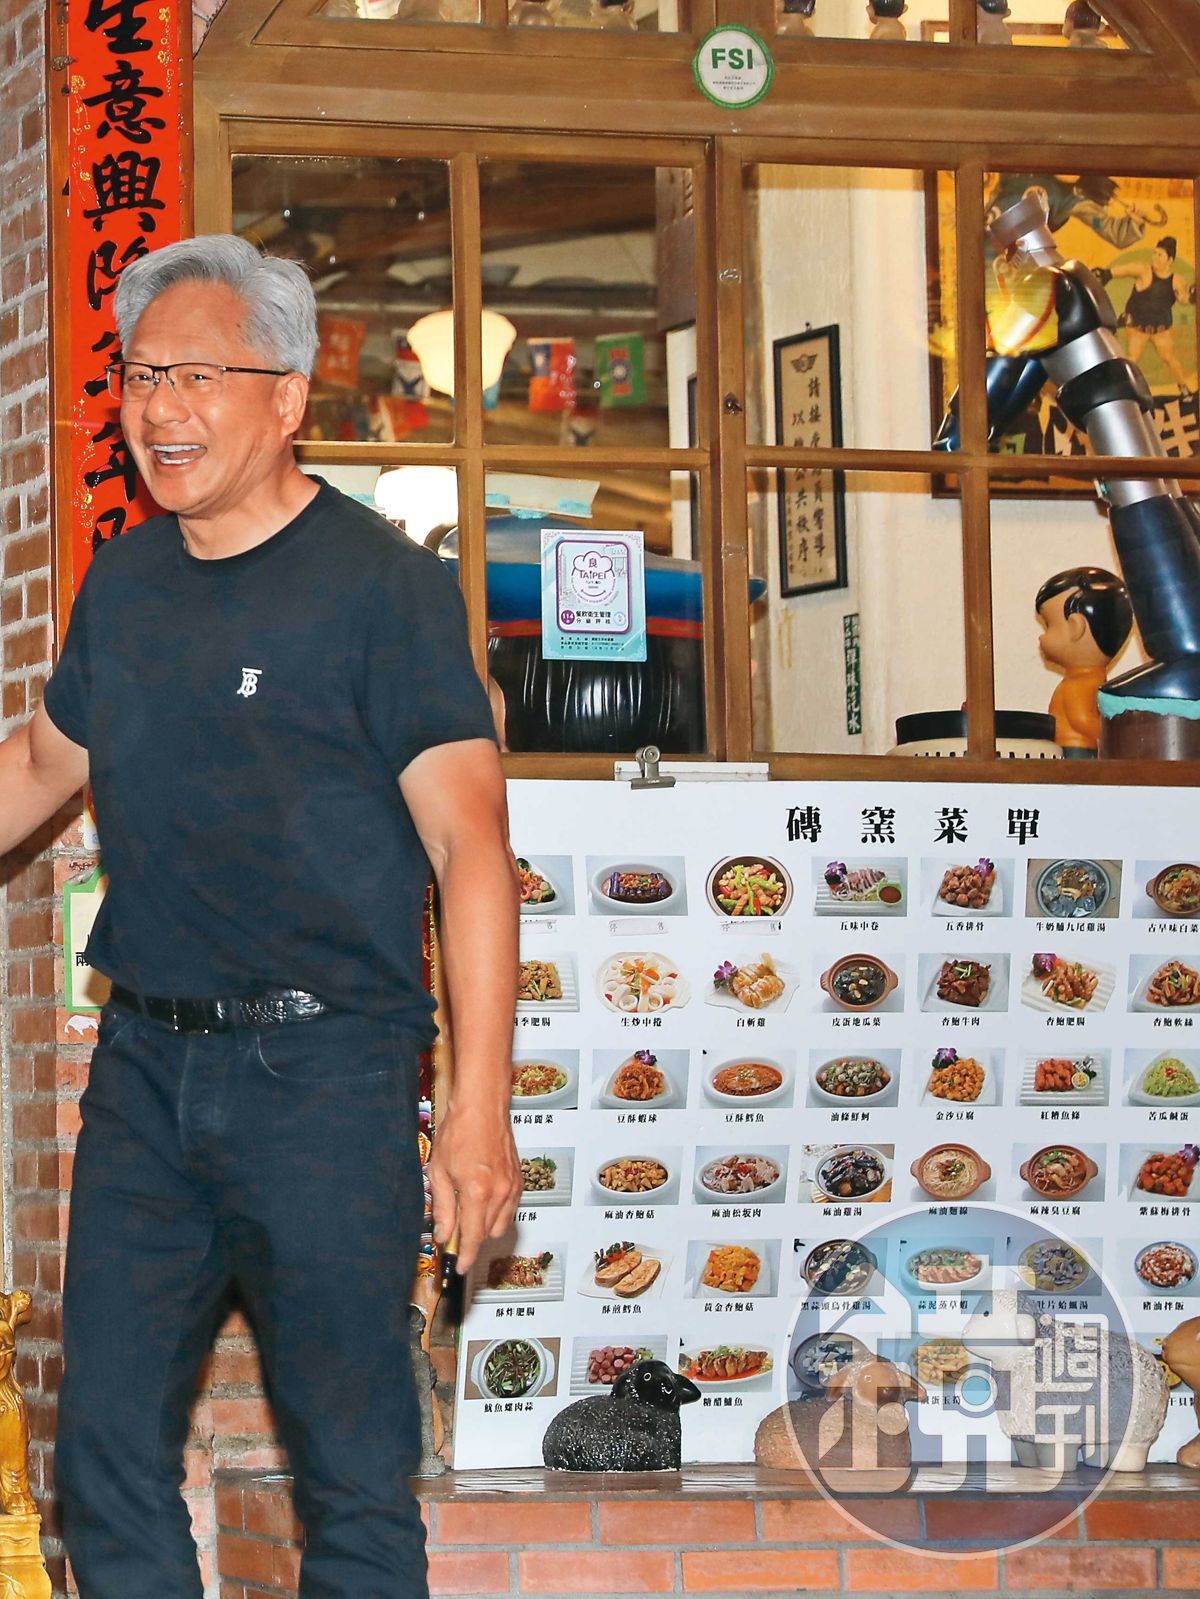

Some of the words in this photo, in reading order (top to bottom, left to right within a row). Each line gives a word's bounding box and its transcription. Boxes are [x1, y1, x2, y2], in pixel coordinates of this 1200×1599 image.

[711, 48, 754, 70] FSI
[786, 806, 1040, 845] 磚窯菜單
[946, 921, 985, 932] 五香排骨
[1148, 923, 1199, 934] 古早味白菜
[736, 1017, 766, 1028] 白斬雞
[941, 1016, 980, 1027] 杏鮑牛肉
[1046, 1016, 1085, 1027] 杏鮑肥腸
[617, 1113, 657, 1124] 豆酥蝦球
[725, 1112, 765, 1123] 豆酥鱈魚
[830, 1111, 870, 1122] 油條鮮蚵
[936, 1110, 975, 1121] 金沙豆腐
[513, 1210, 537, 1222] 仔酥
[604, 1209, 655, 1220] 麻油杏鮑菇
[822, 1207, 862, 1217] 麻油雞湯
[1030, 1205, 1081, 1216] 麻辣臭豆腐
[1139, 1206, 1191, 1217] 紫蘇梅排骨
[601, 1304, 642, 1314] 酥煎鱈魚
[704, 1302, 754, 1312] 黃金杏鮑菇
[1142, 1301, 1184, 1311] 豬油拌飯
[495, 1306, 535, 1318] 酥炸肥腸
[483, 1401, 534, 1413] 魷魚螺肉蒜
